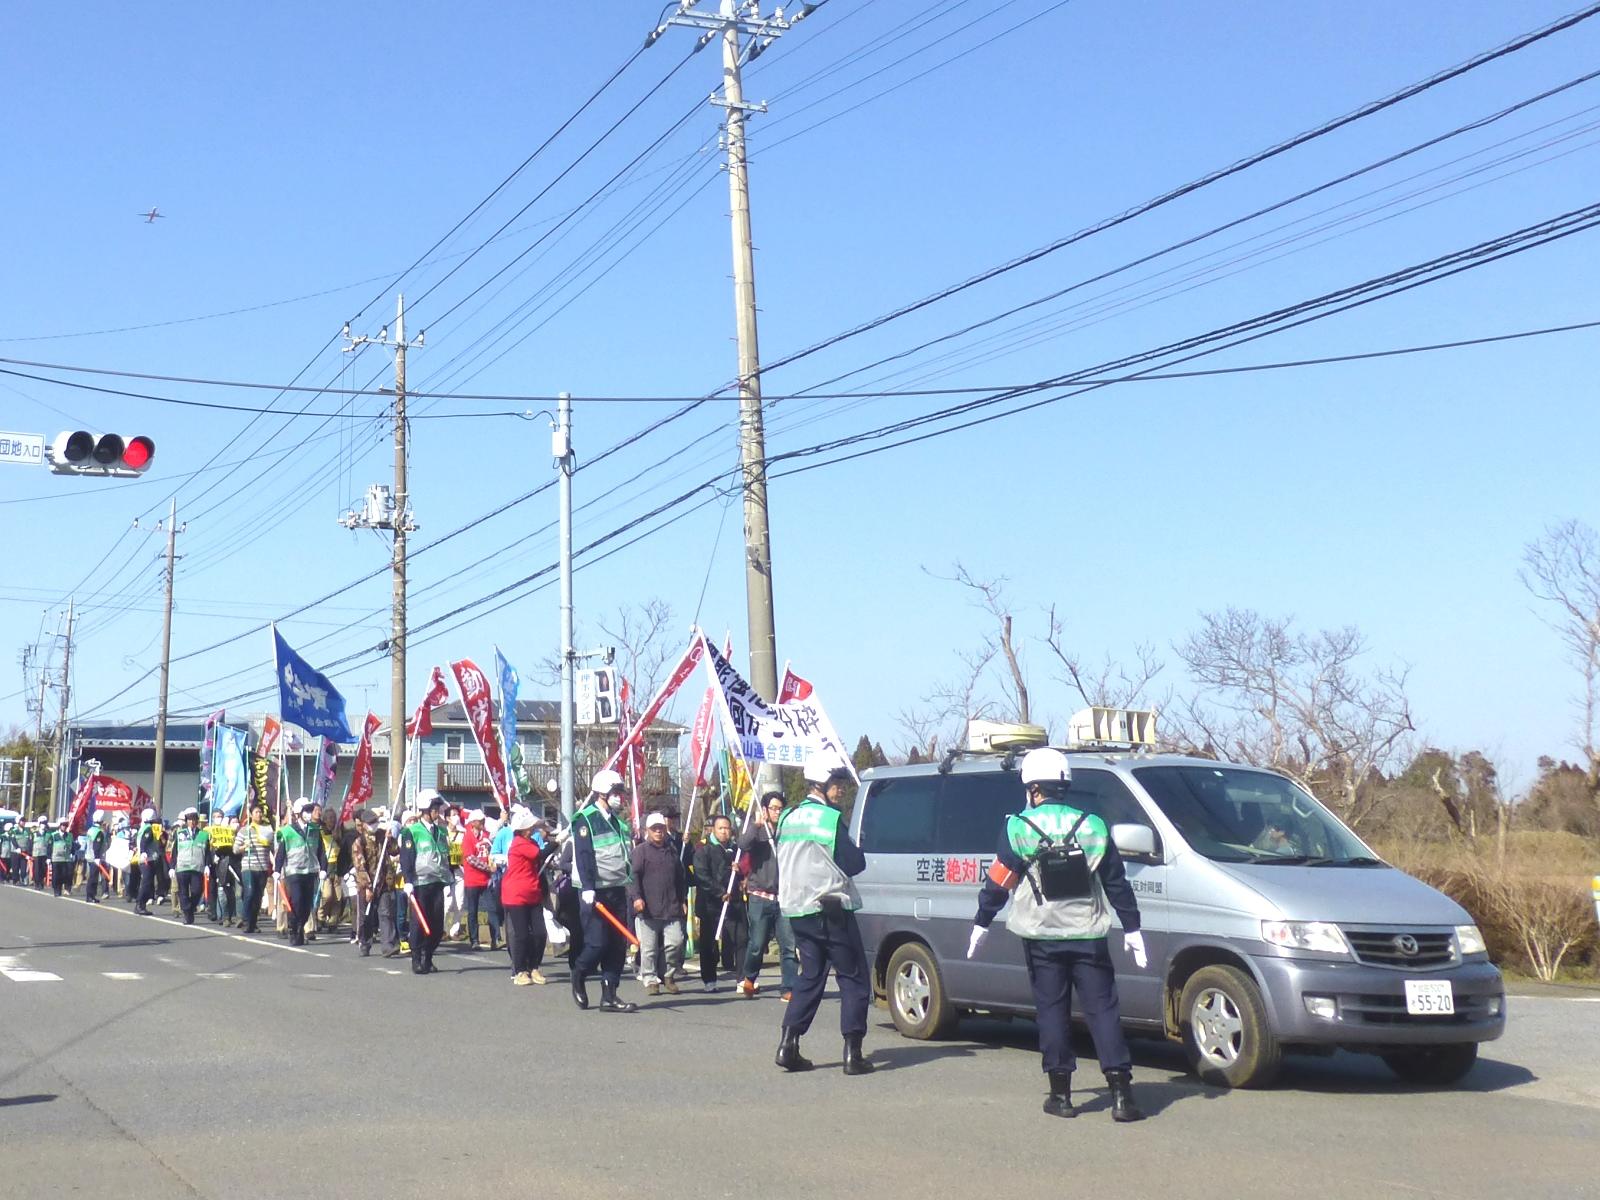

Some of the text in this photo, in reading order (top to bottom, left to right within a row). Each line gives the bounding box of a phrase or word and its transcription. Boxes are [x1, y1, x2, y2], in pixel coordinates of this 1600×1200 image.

[0, 439, 40, 457] 団地入口
[1417, 994, 1452, 1011] 55-20
